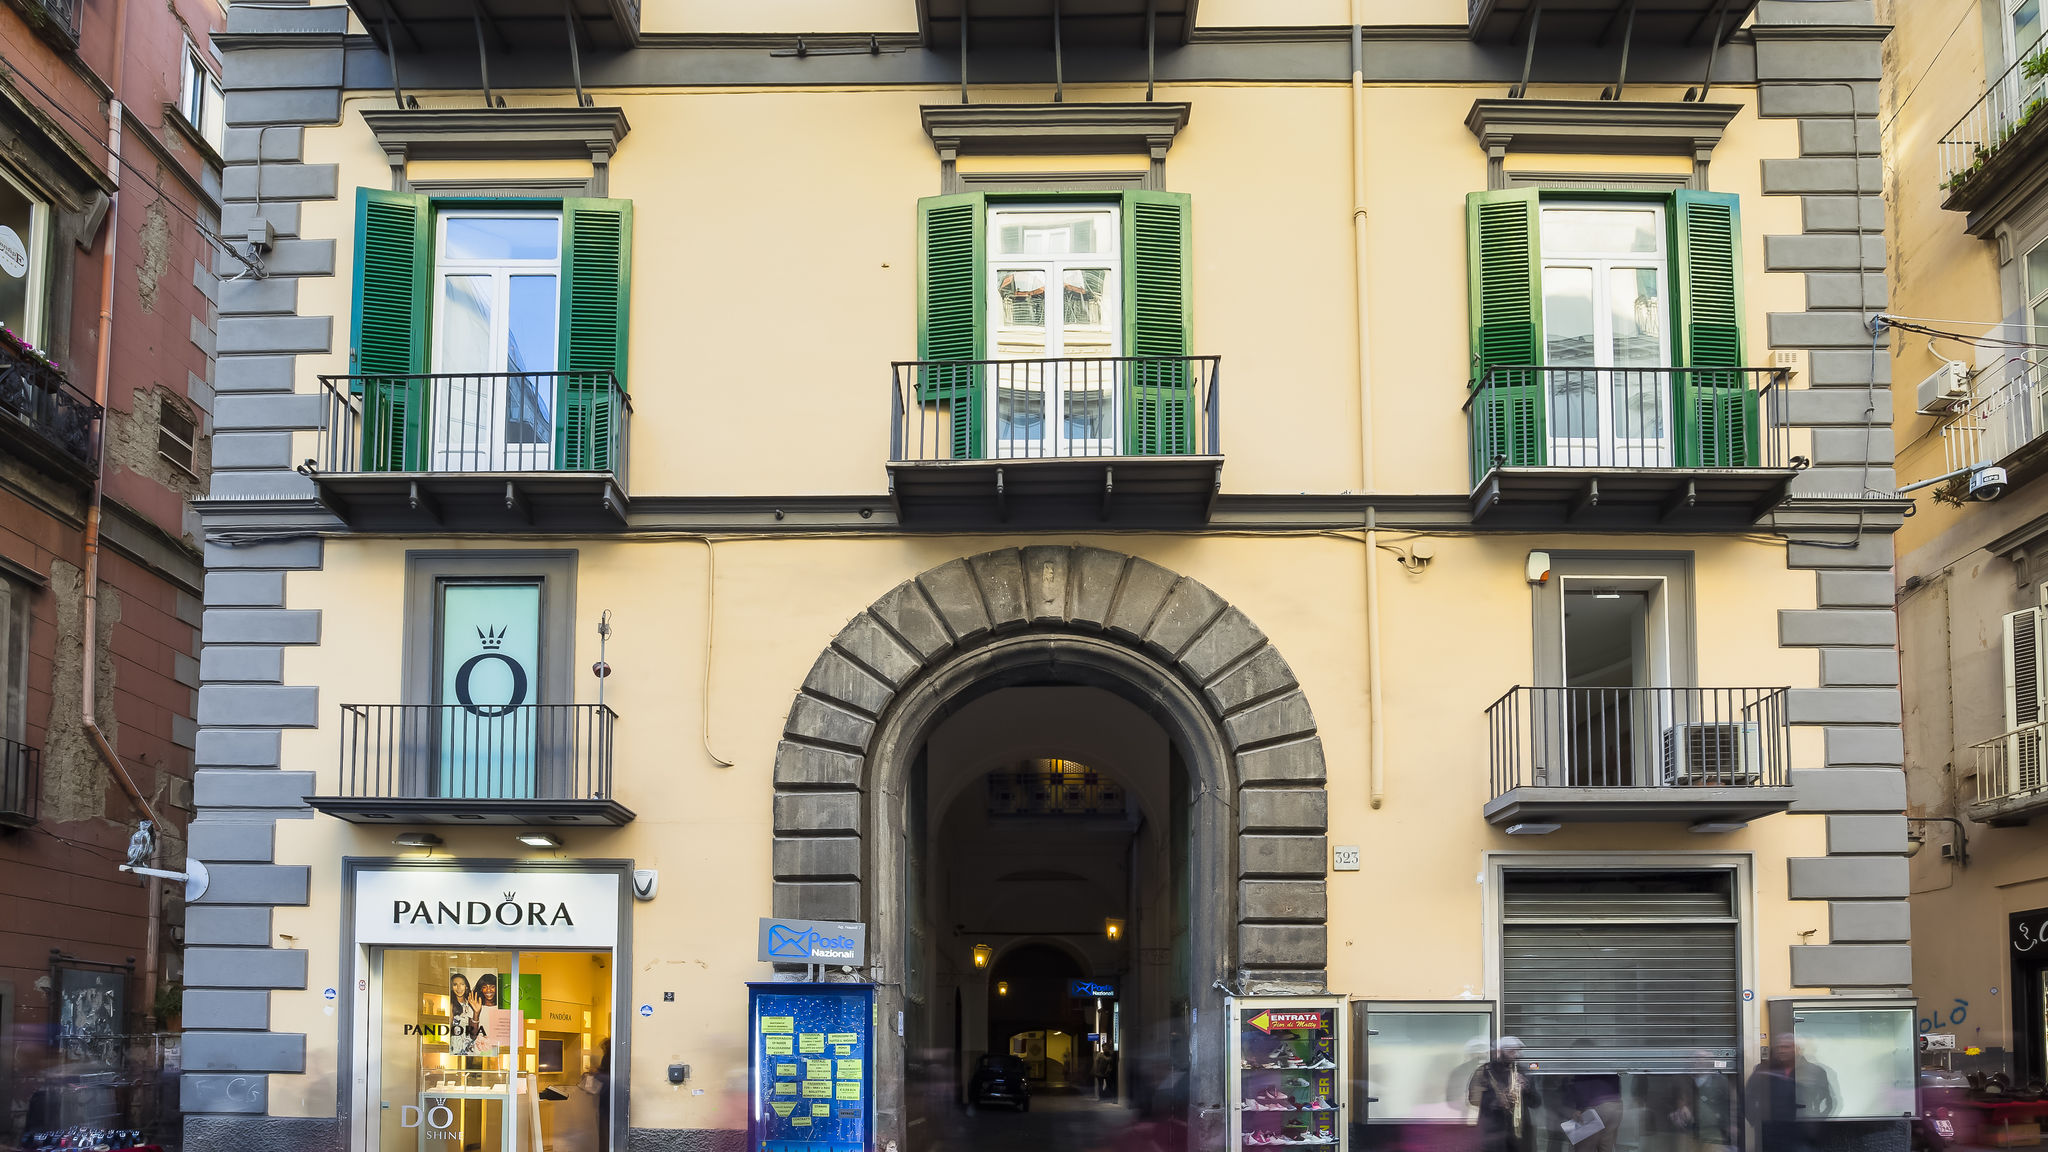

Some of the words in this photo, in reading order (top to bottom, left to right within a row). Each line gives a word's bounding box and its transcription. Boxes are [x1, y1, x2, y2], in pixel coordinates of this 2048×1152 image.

[1335, 851, 1359, 864] 323
[393, 900, 575, 926] PANDORA
[808, 932, 855, 950] Poste
[811, 948, 855, 959] Nazionali
[549, 1012, 572, 1021] PANDORA
[403, 1024, 488, 1037] PANDORA
[401, 1104, 454, 1130] DO
[426, 1131, 465, 1141] SHINE
